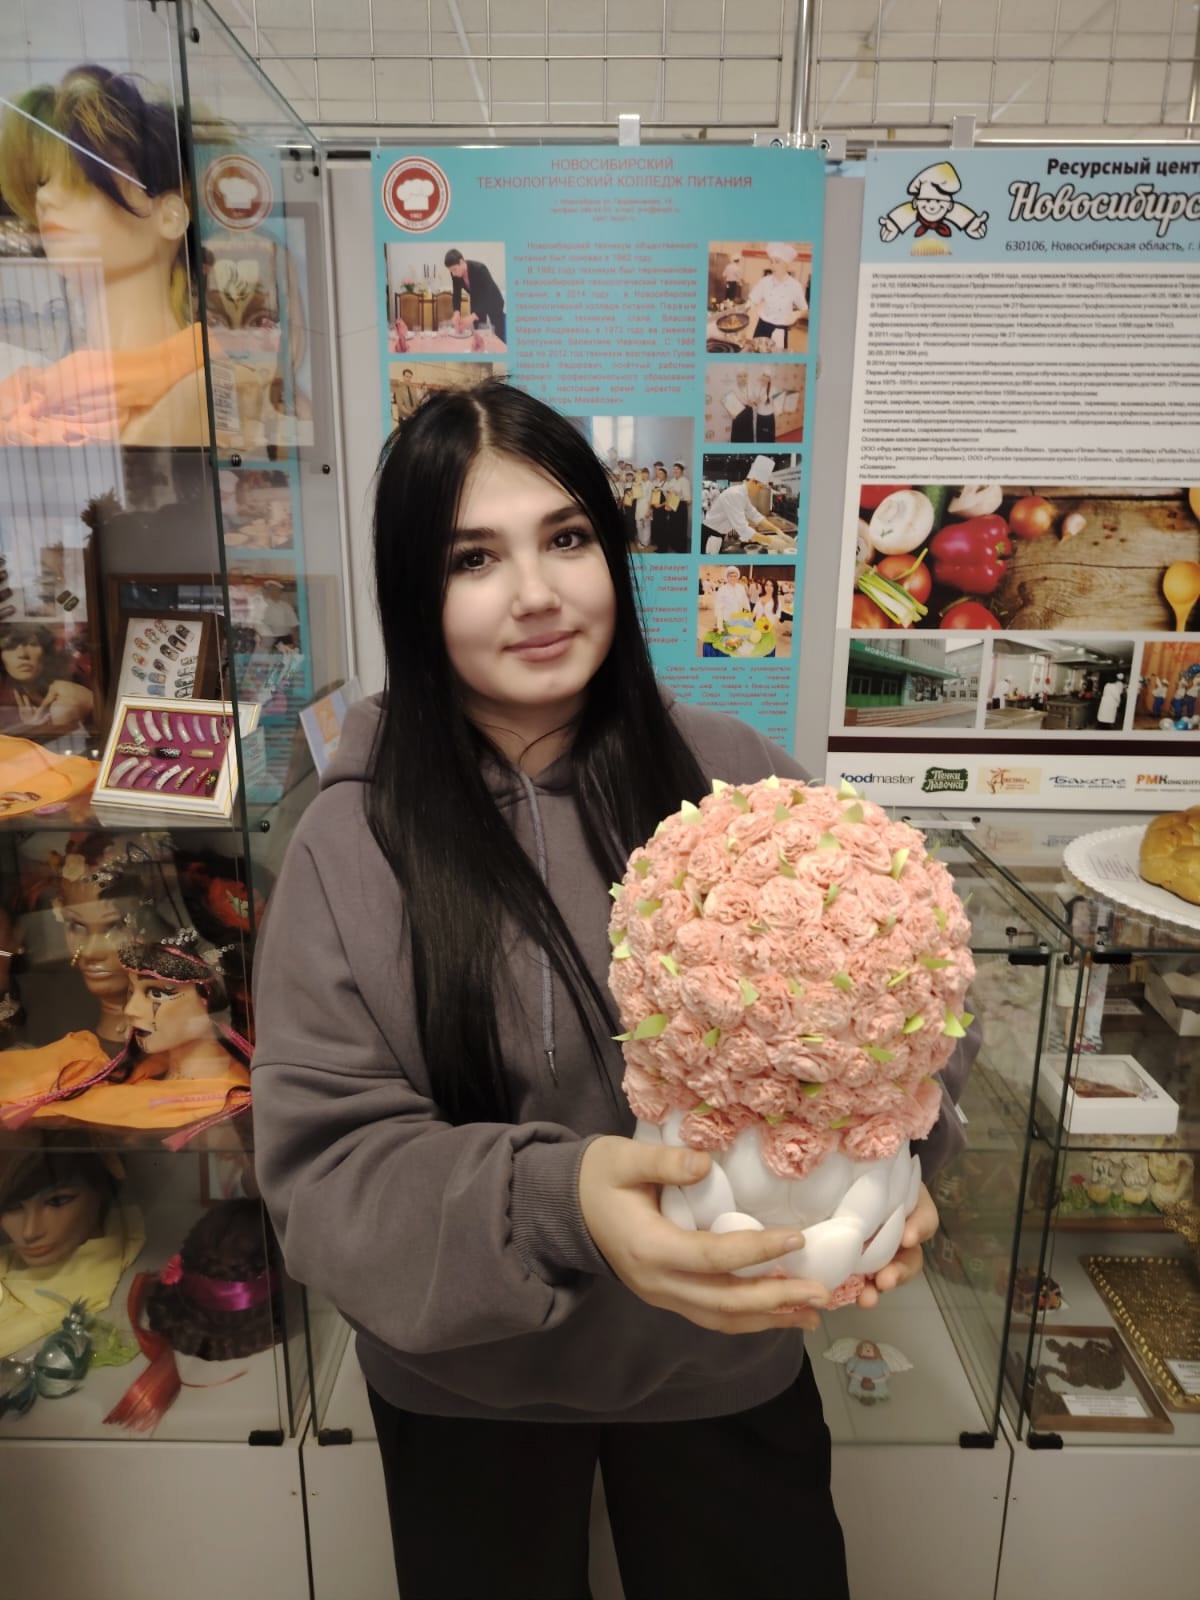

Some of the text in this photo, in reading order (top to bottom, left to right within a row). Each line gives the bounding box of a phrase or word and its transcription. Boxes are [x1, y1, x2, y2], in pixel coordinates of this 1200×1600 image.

[551, 157, 674, 171] НОВОСИБИРСКИЙ
[1047, 157, 1151, 177] Ресурсный
[477, 175, 752, 190] ТЕХНОЛОГИЧЕСКИЙ КОЛЛЕДЖ ПИТАНИЯ
[1005, 240, 1048, 252] 630106,
[1051, 239, 1135, 253] Новосибирская
[1138, 240, 1184, 253] область,
